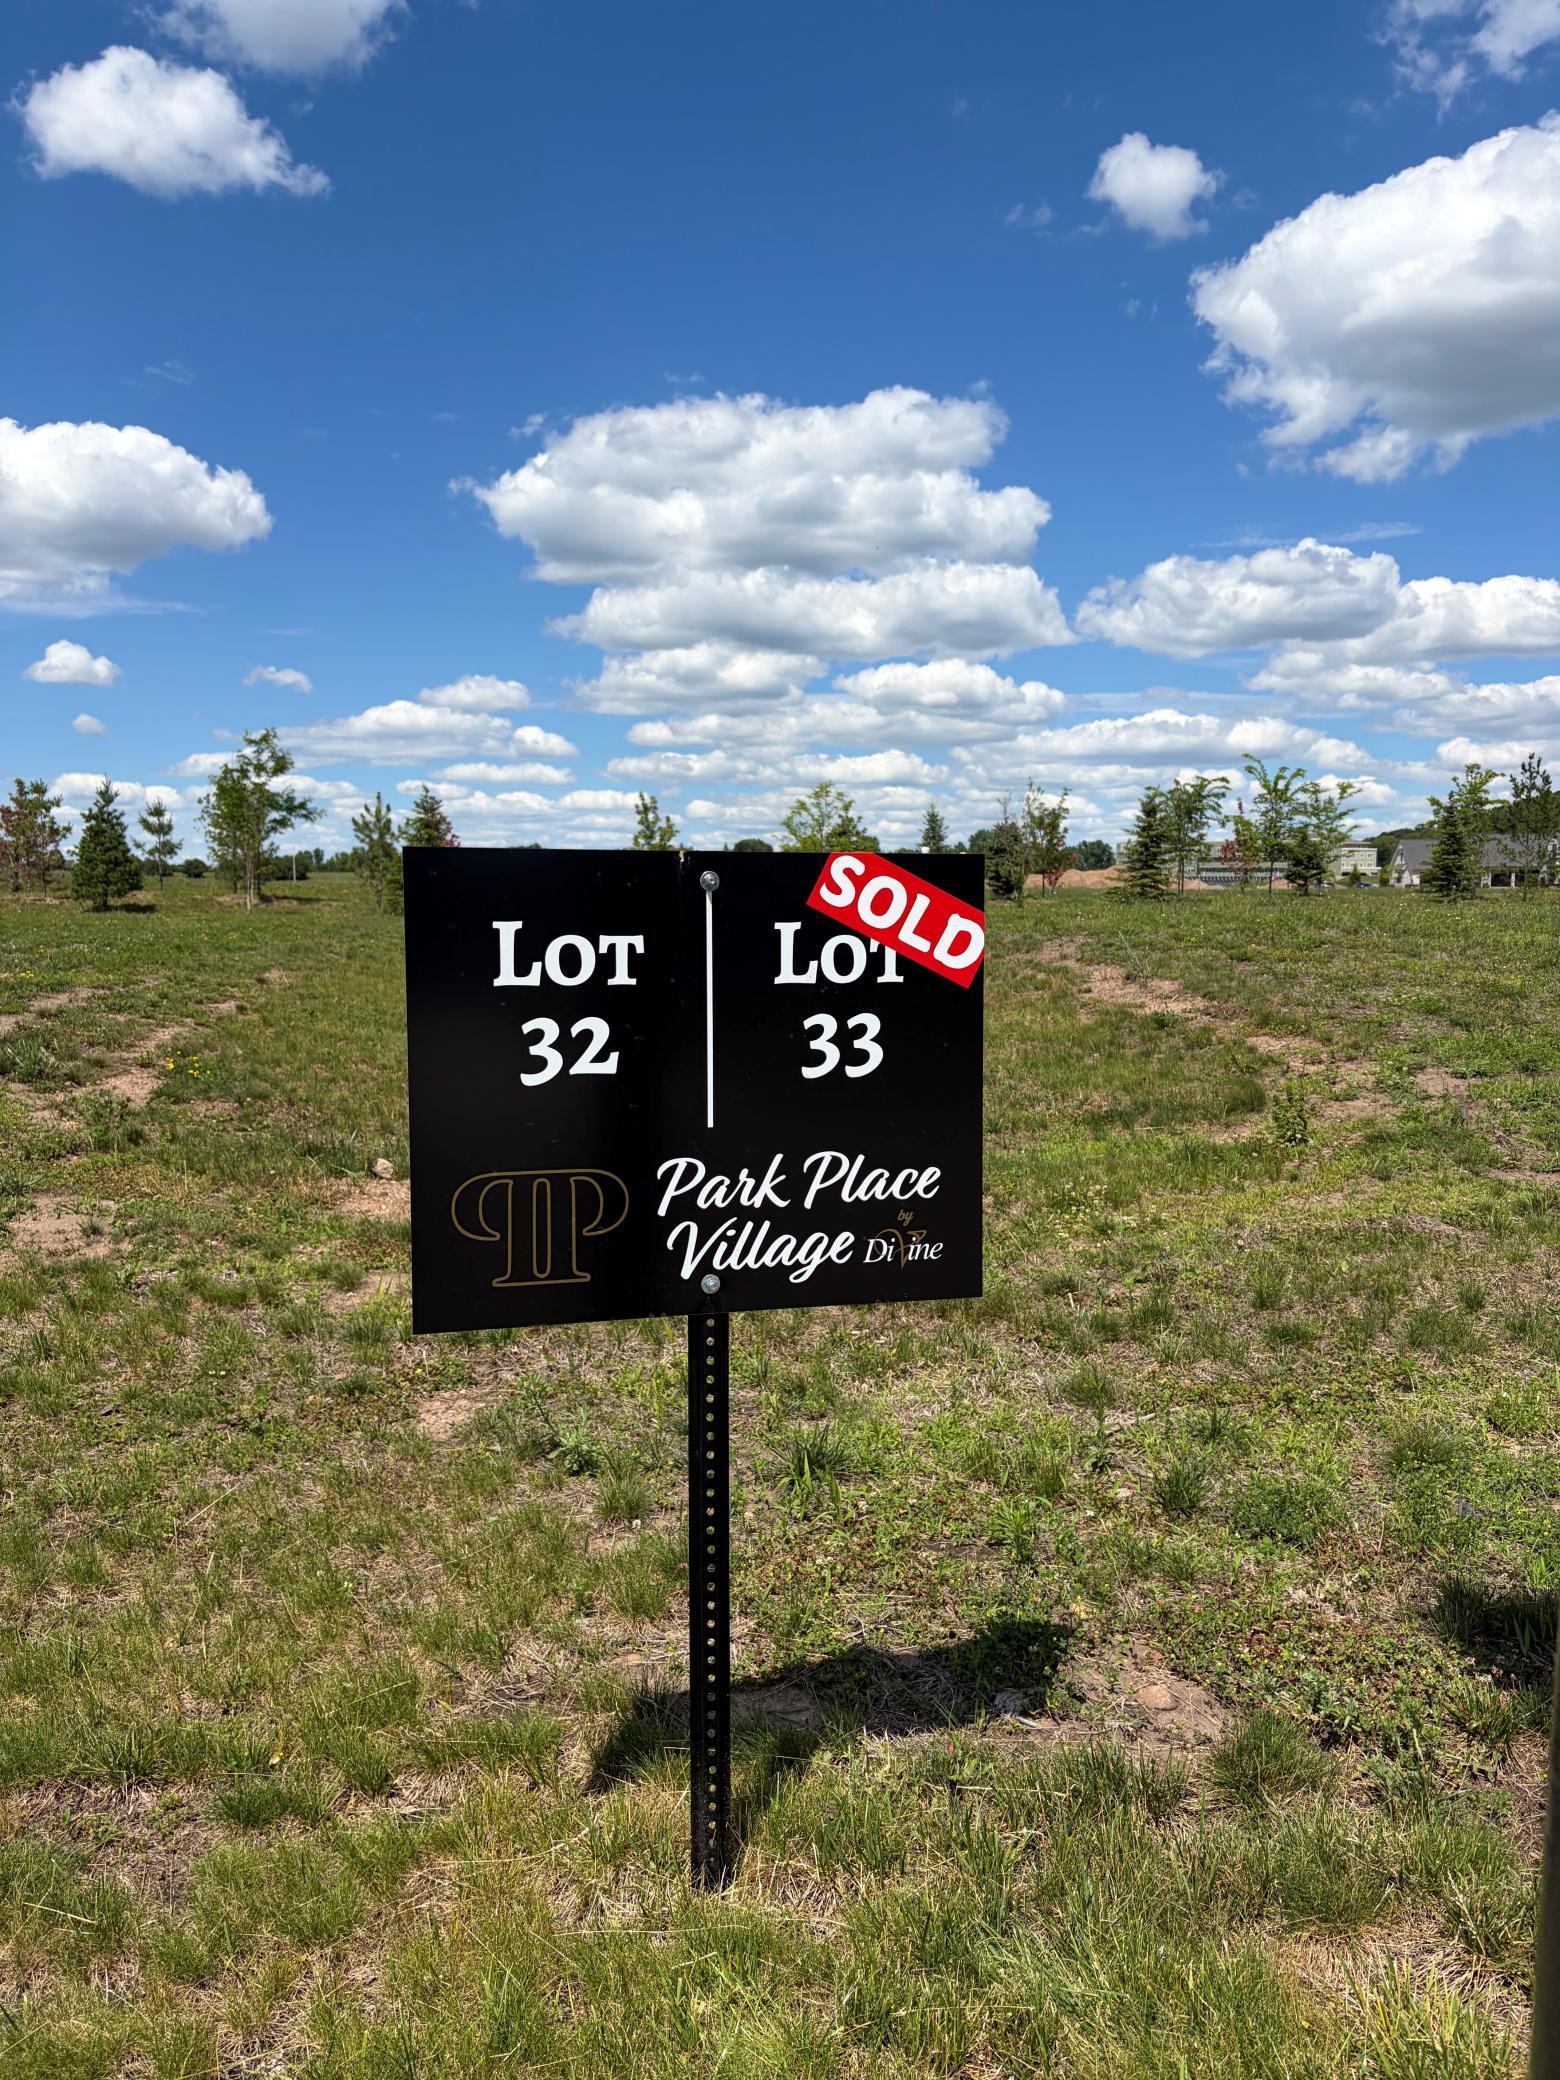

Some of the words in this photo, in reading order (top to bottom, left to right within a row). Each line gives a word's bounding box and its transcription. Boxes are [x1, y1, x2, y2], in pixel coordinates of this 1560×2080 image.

[819, 855, 985, 970] SOLD
[520, 1016, 620, 1087] 32
[801, 1012, 884, 1079] 33
[656, 1153, 790, 1217] Park
[803, 1150, 942, 1210] Place
[666, 1216, 855, 1284] Village
[897, 1209, 914, 1227] by
